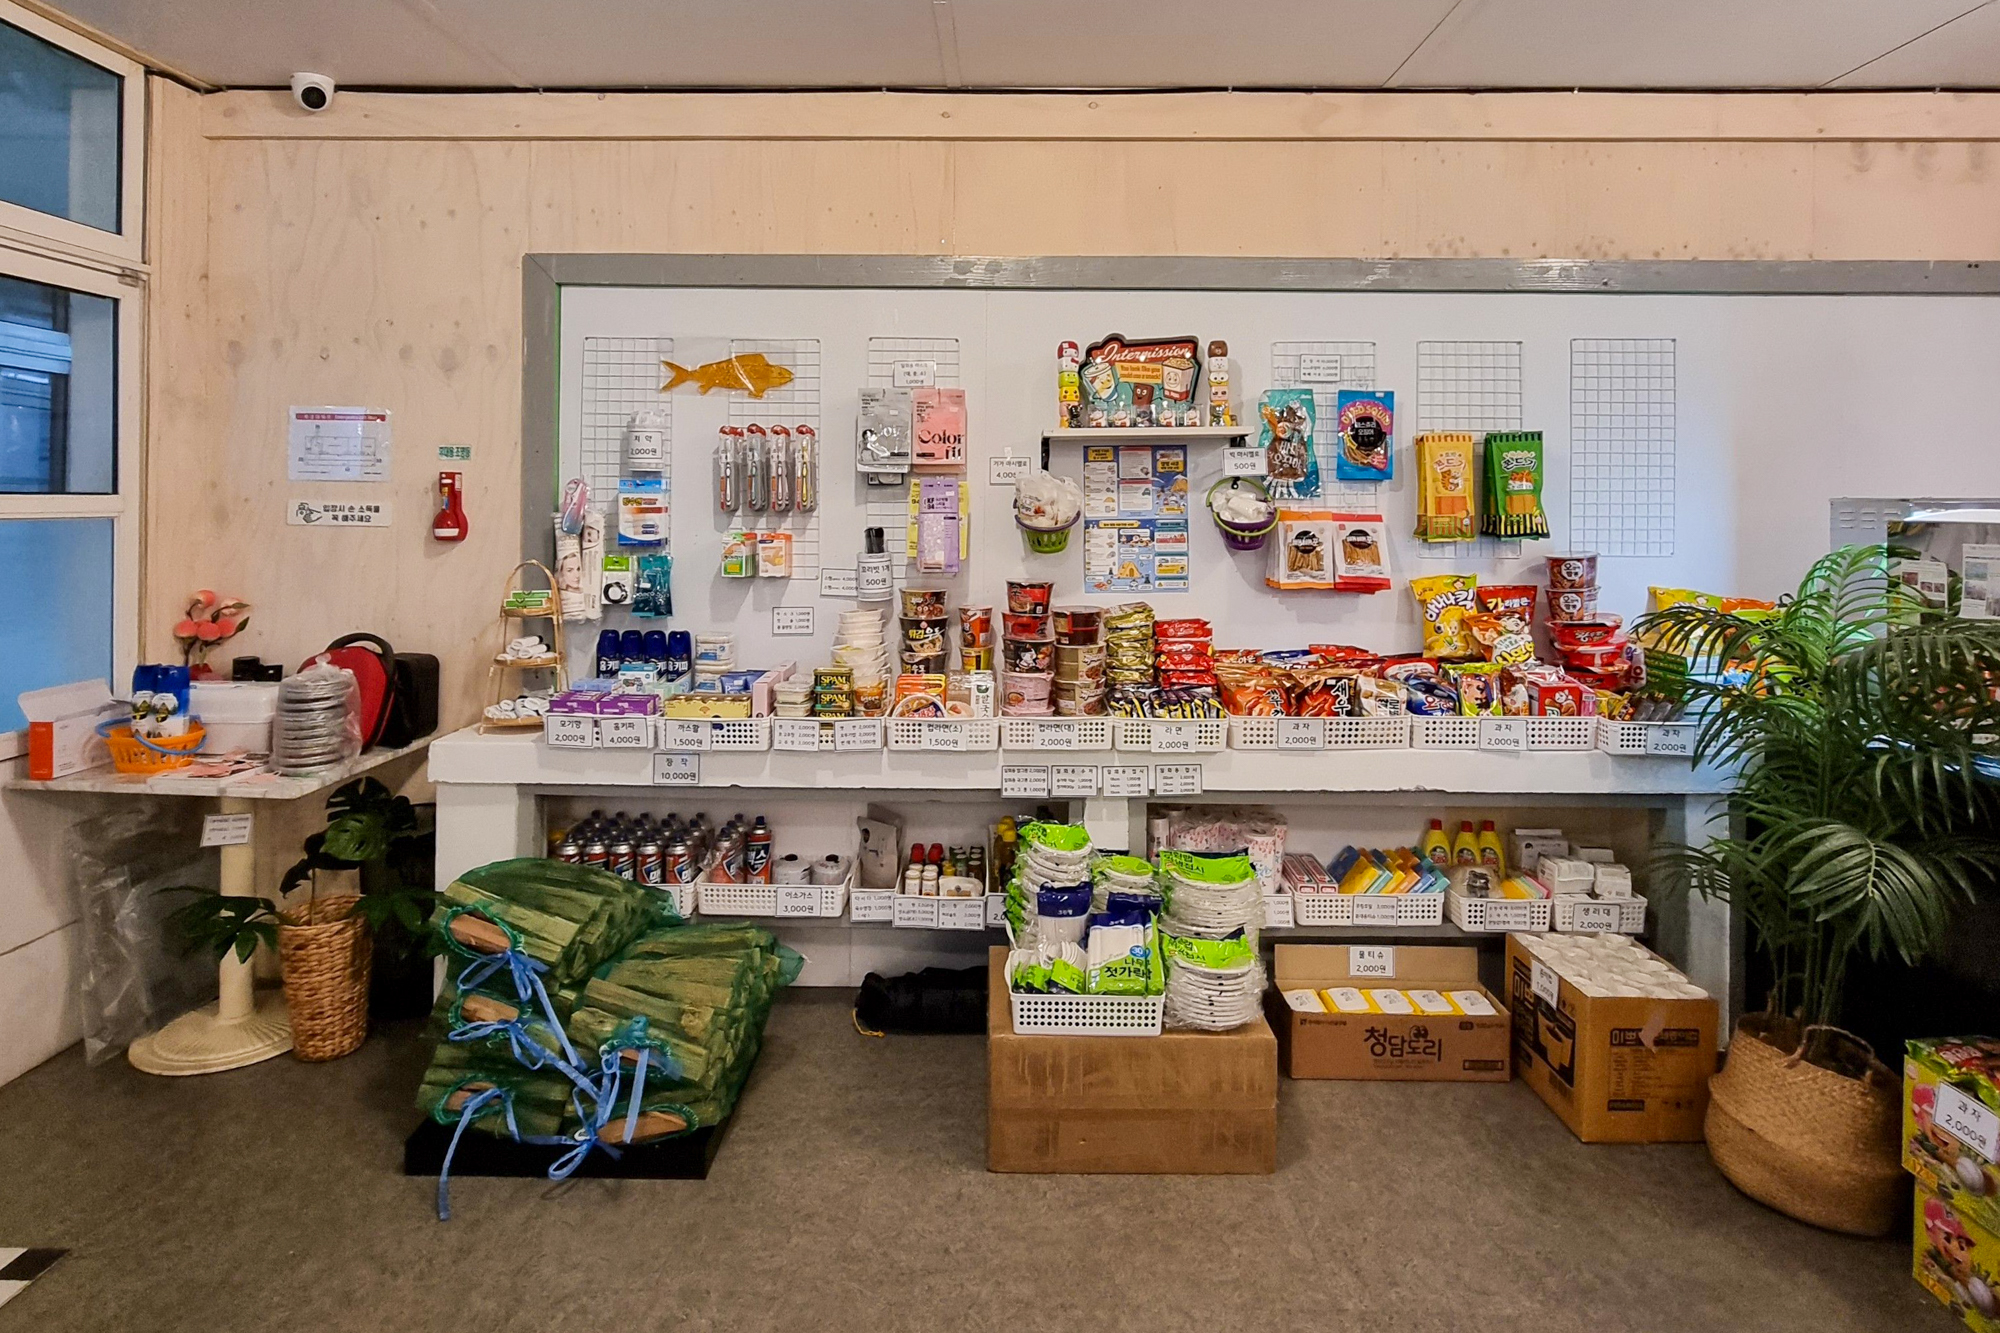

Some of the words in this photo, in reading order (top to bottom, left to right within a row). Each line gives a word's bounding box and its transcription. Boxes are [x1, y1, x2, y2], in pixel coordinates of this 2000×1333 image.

[1096, 344, 1192, 364] Intermission
[918, 428, 965, 446] Color
[1233, 462, 1256, 470] 500원
[322, 504, 345, 514] 입장시
[347, 504, 355, 514] 손
[358, 504, 380, 514] 소독을
[341, 514, 372, 523] 해주세요
[881, 564, 890, 572] 1개
[865, 577, 887, 586] 500원
[1425, 588, 1476, 622] 바나나킥
[820, 675, 847, 684] SPAM
[820, 693, 847, 702] SPAM
[1331, 679, 1351, 717] 새우
[559, 720, 582, 729] 모기향
[927, 723, 963, 733] 컵라면(소)
[1038, 723, 1075, 733] 컵라면(대)
[554, 733, 586, 743] 2,000원
[609, 736, 641, 745] 4,000원
[673, 738, 703, 747] 1,500원
[1285, 736, 1317, 745] 2,000원
[1487, 738, 1520, 747] 2,000원
[928, 738, 959, 748] 1,500원
[1040, 738, 1072, 748] 2,000원
[1158, 741, 1189, 750] 2,000원
[1653, 743, 1687, 753] 2,000원
[660, 772, 697, 781] 10,000원
[784, 891, 813, 900] 이소가스
[783, 905, 814, 914] 3,000원
[1579, 921, 1612, 930] 2,000원
[1105, 966, 1152, 980] 젓가락
[1356, 964, 1387, 974] 2,000원
[1363, 1026, 1443, 1062] 청담도리
[1945, 1114, 1987, 1150] 2,000원
